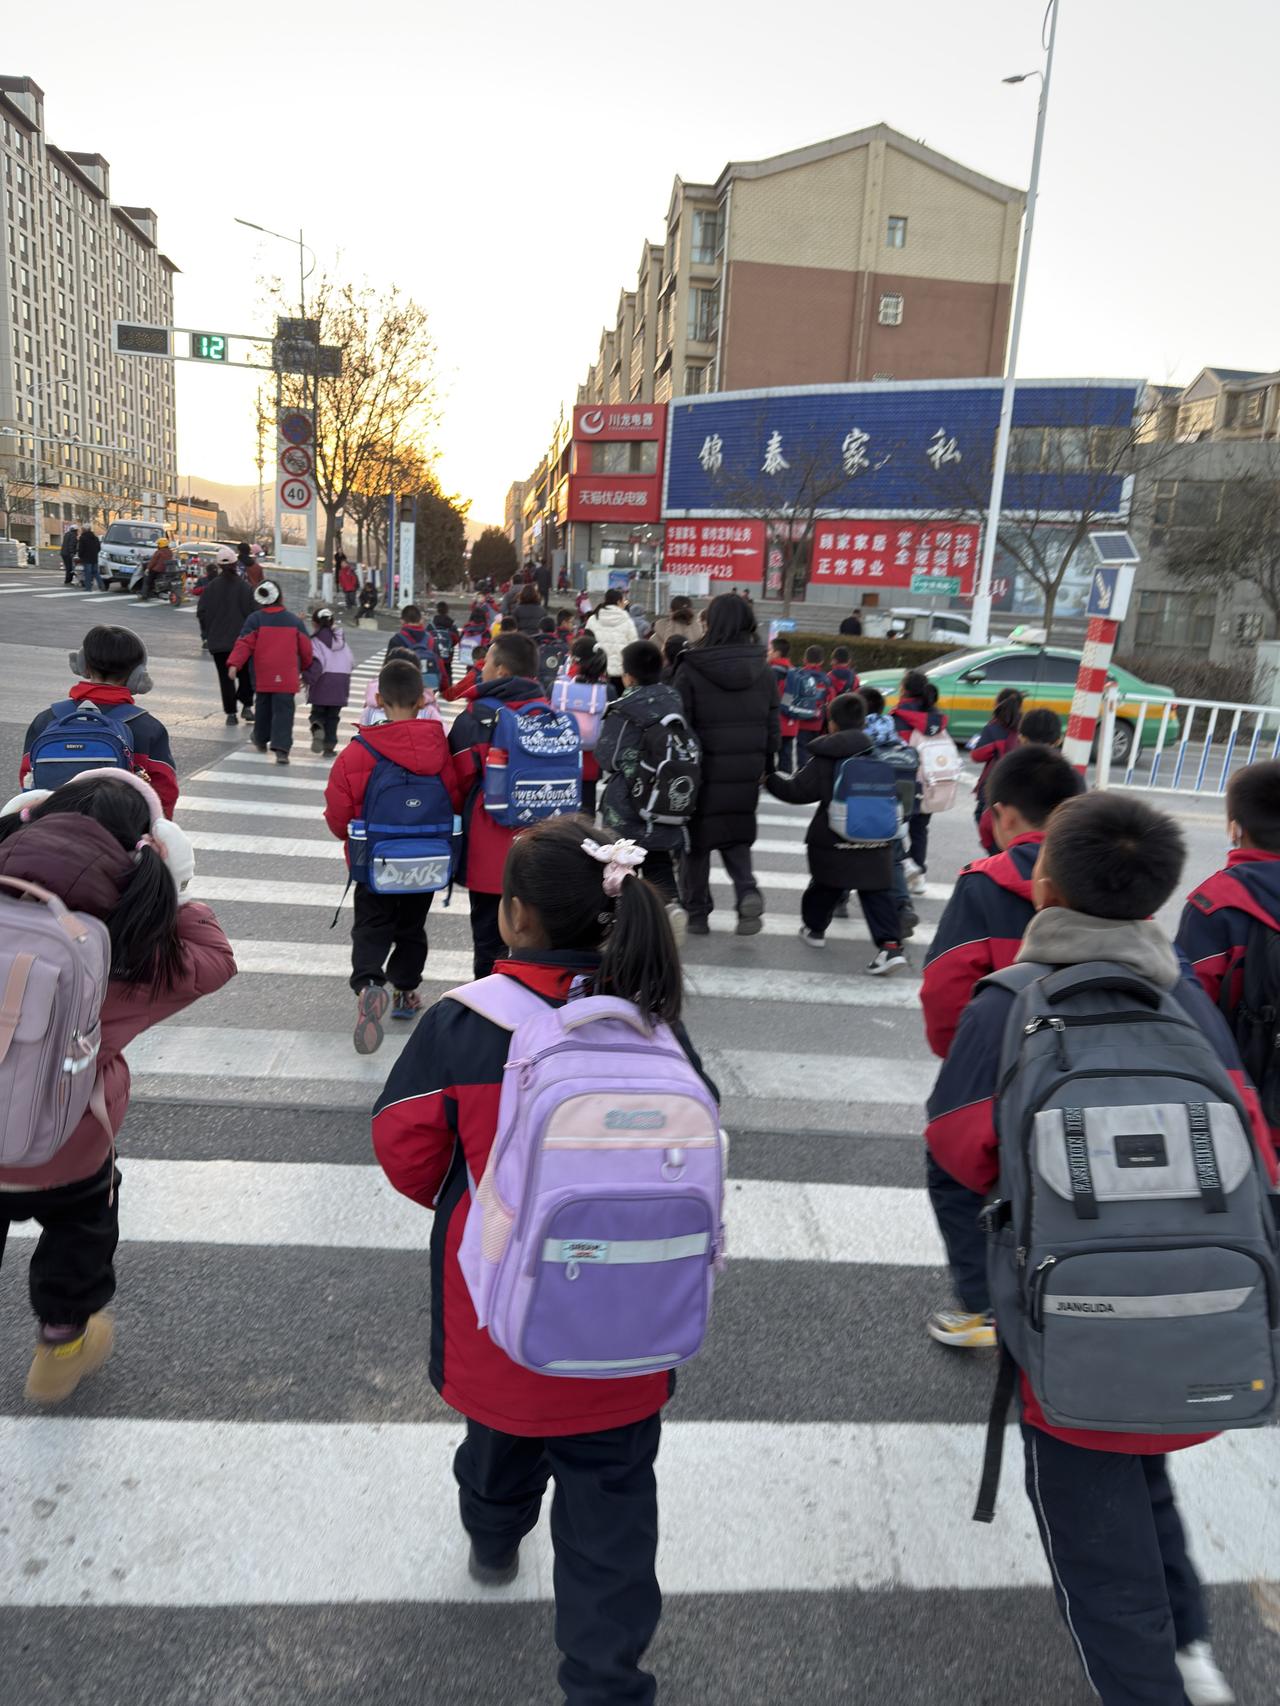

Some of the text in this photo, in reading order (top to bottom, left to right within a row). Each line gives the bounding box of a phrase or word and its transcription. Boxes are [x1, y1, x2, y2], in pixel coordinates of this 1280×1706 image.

[201, 336, 224, 359] 12
[288, 488, 304, 501] 40
[819, 533, 887, 552] 顾家家居
[816, 558, 885, 577] 正常营业
[1066, 1136, 1092, 1193] FASHION
[1191, 1132, 1220, 1188] FASHION
